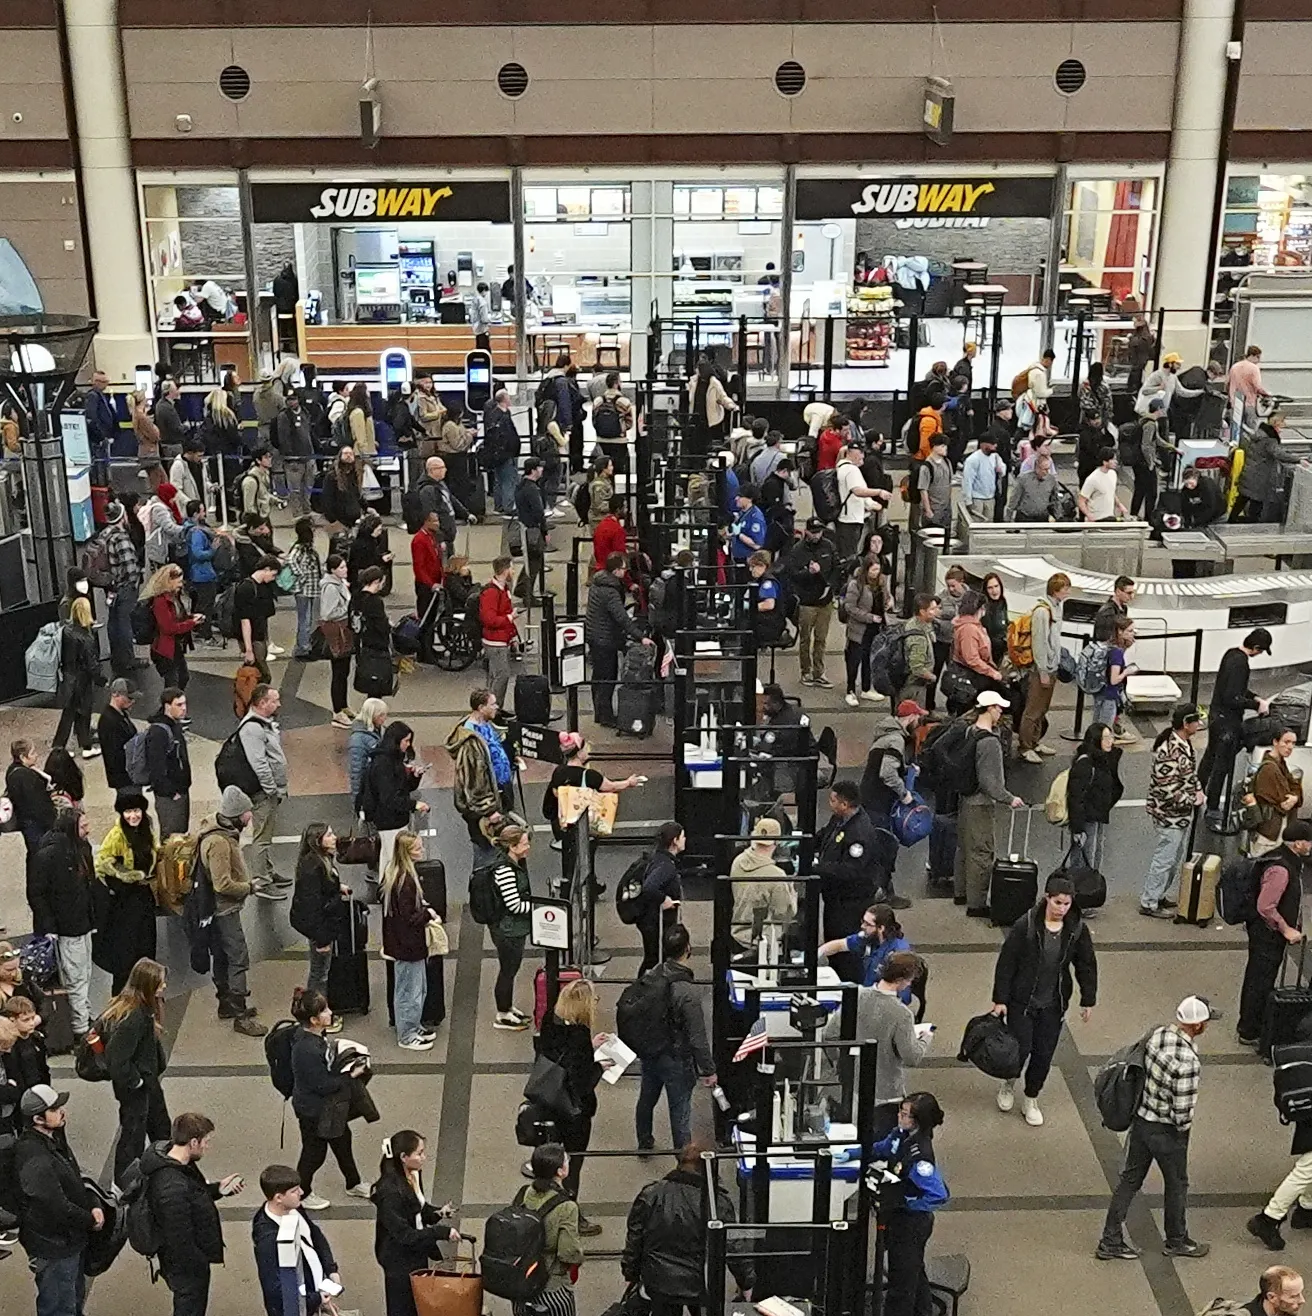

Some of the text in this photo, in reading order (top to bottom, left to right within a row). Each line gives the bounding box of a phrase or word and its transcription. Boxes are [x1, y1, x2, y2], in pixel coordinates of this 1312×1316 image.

[309, 186, 453, 219] SUBWAY
[850, 182, 995, 215] SUBWAY
[521, 726, 543, 741] Please
